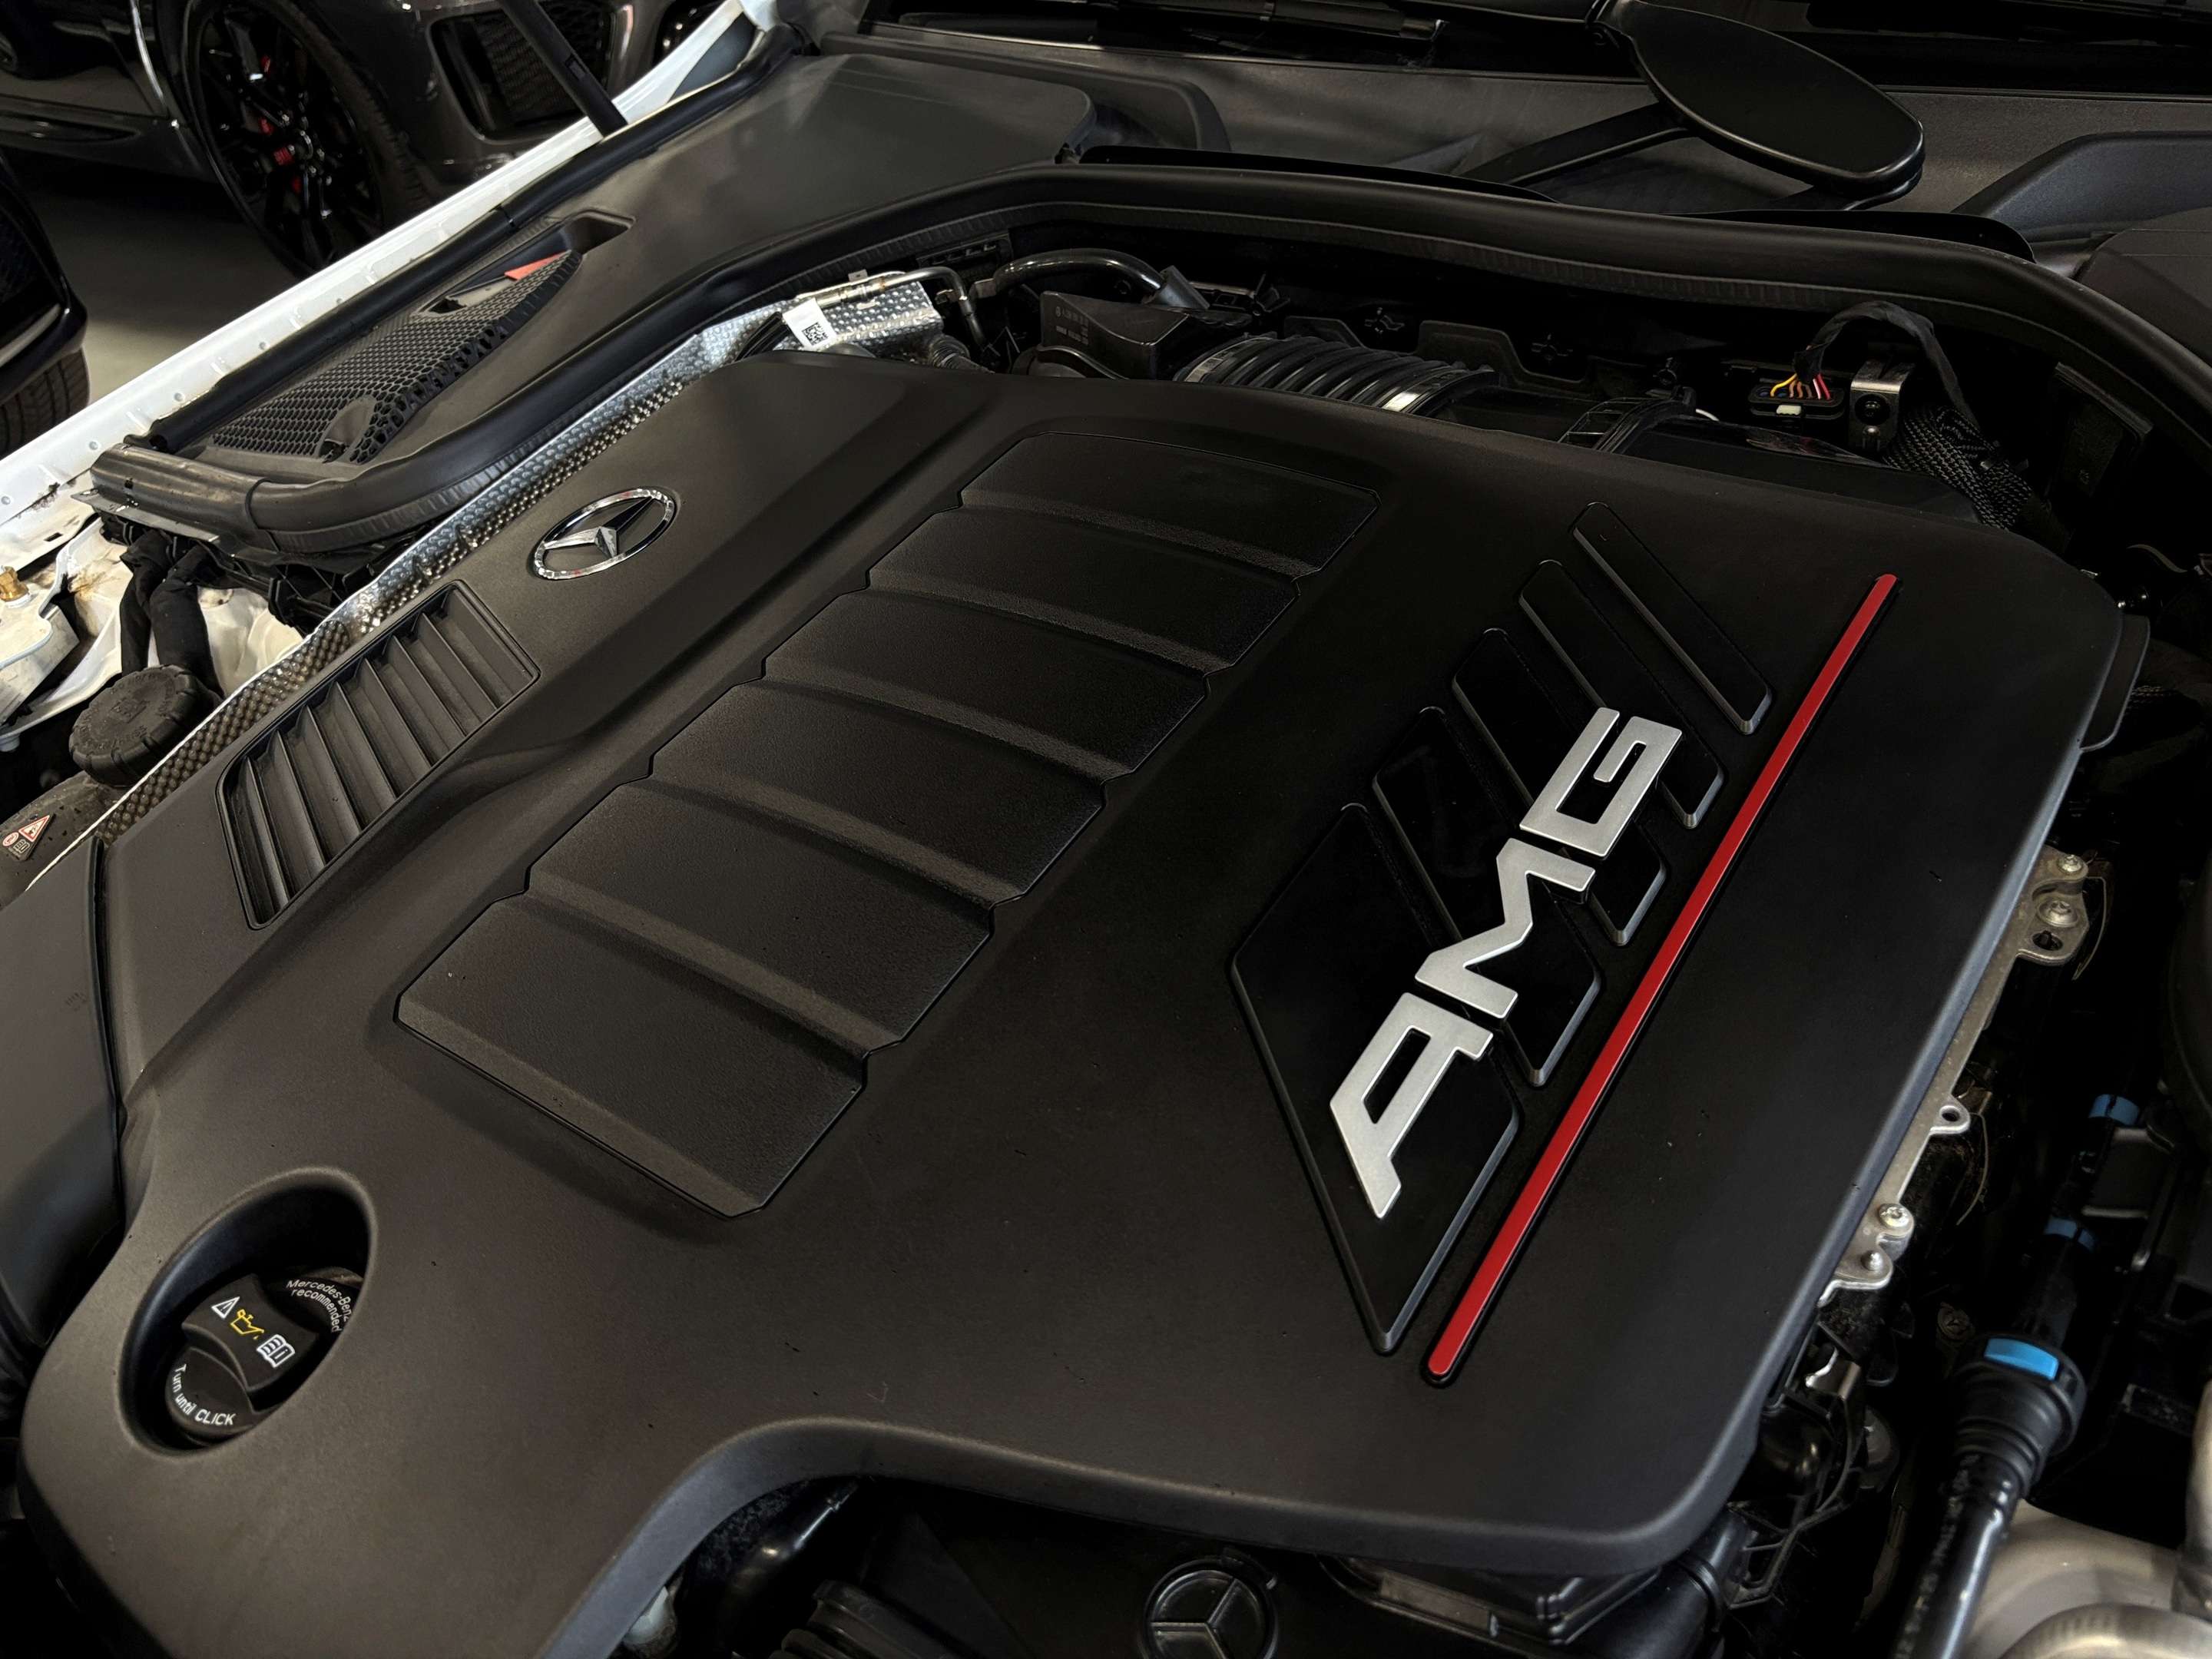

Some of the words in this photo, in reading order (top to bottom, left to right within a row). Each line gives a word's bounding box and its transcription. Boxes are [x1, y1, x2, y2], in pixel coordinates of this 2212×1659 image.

[1330, 707, 1681, 1219] AMG
[290, 1289, 343, 1333] recommended
[172, 1363, 187, 1392] Turn
[175, 1392, 197, 1416] until
[194, 1409, 237, 1426] CLICK
